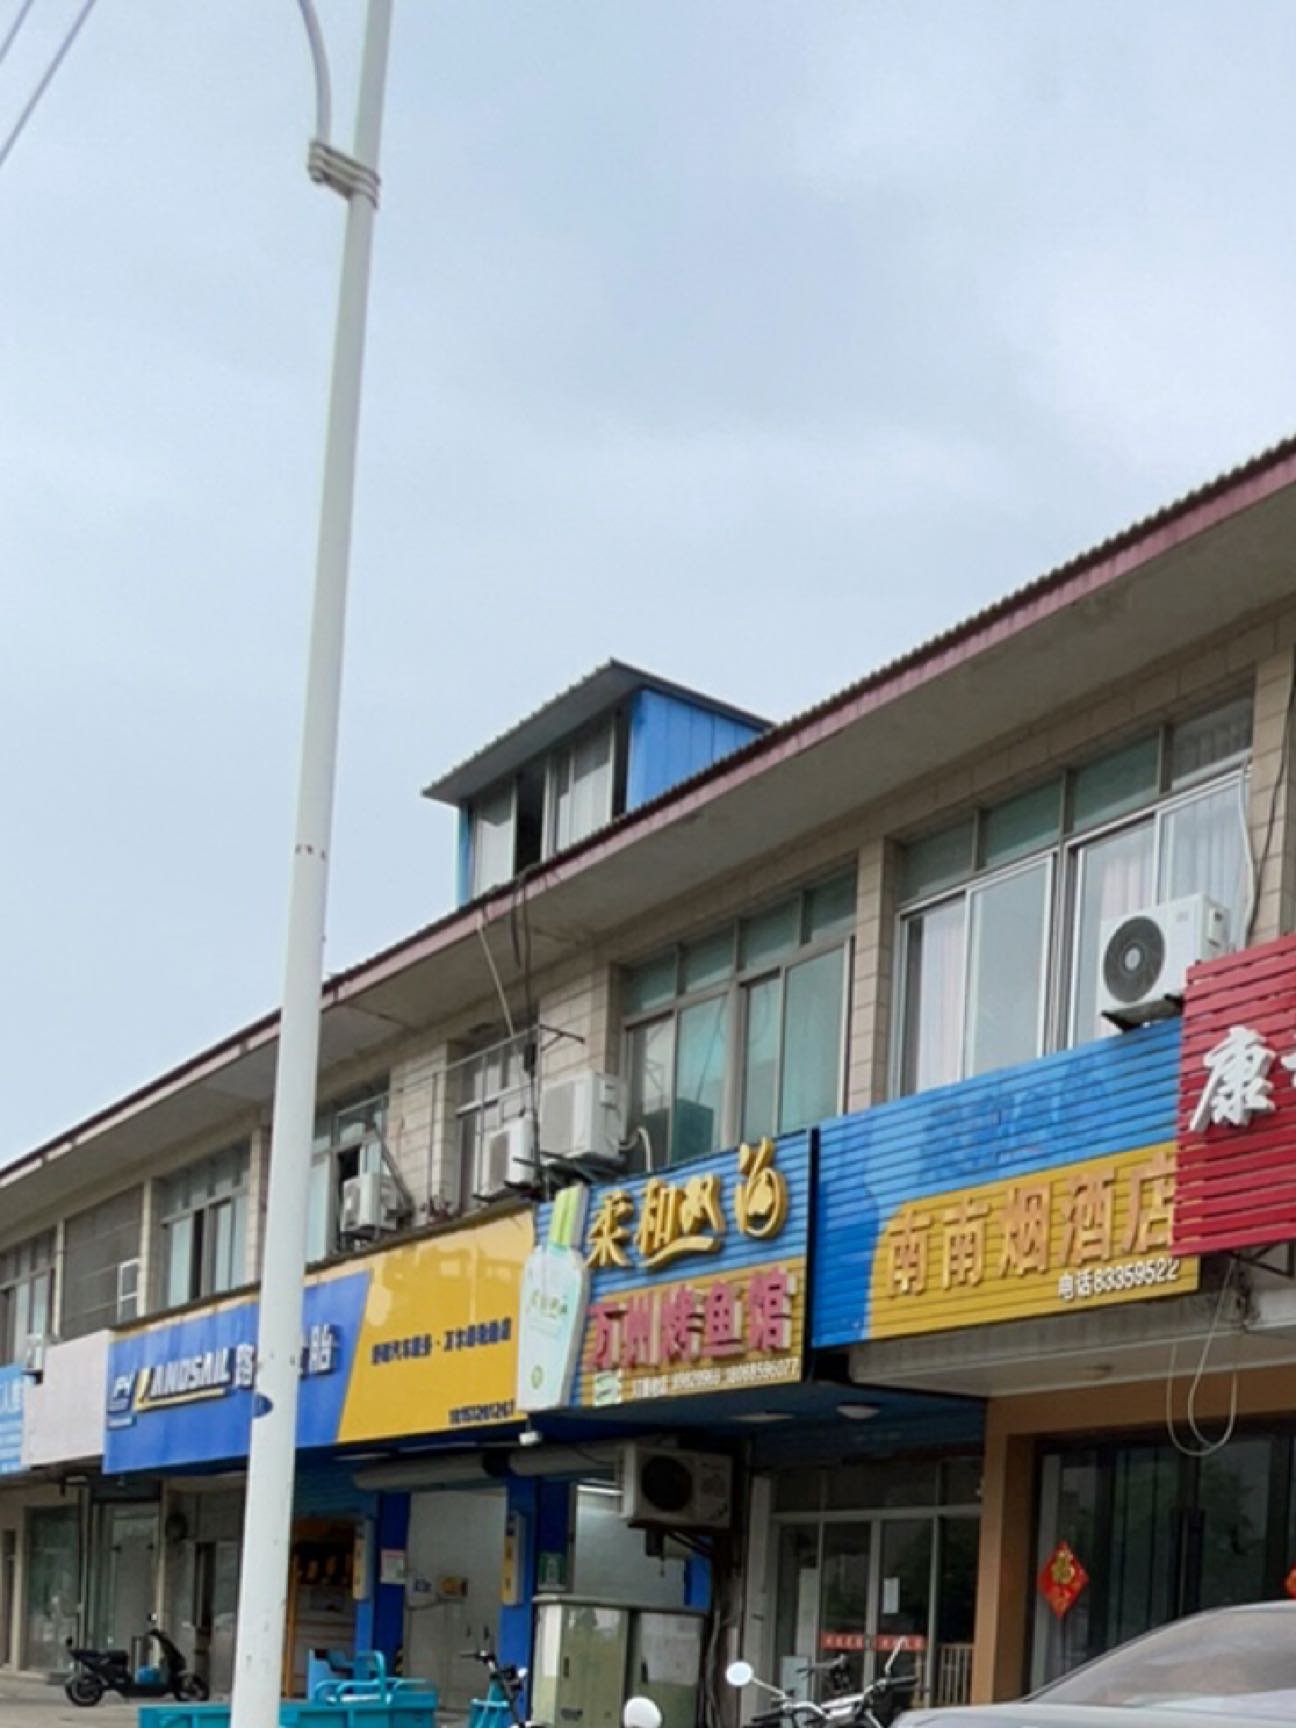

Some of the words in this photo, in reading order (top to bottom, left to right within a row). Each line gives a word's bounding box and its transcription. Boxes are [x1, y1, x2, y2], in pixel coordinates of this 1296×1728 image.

[888, 1150, 1177, 1297] 南南烟酒店
